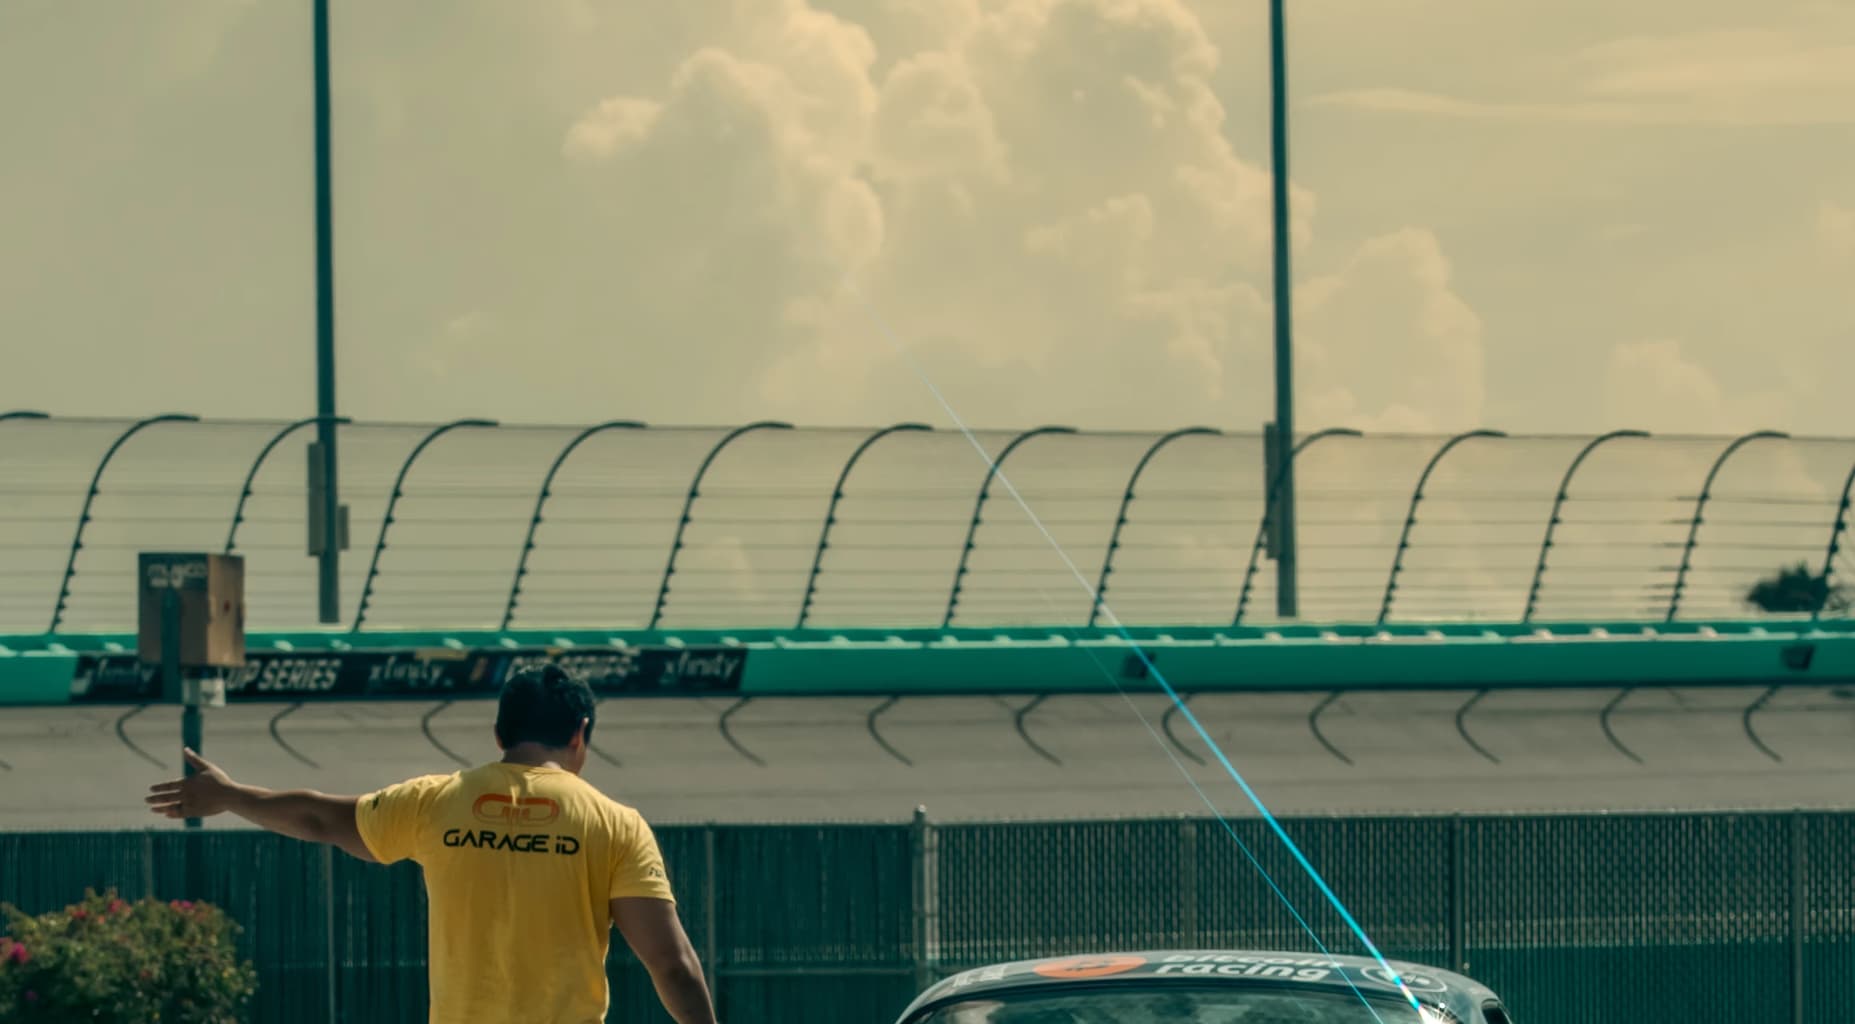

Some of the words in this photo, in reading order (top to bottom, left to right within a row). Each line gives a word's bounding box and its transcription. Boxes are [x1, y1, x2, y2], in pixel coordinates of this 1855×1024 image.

[258, 658, 342, 691] SERIES
[443, 829, 550, 853] GARAGE
[1155, 962, 1331, 982] racing
